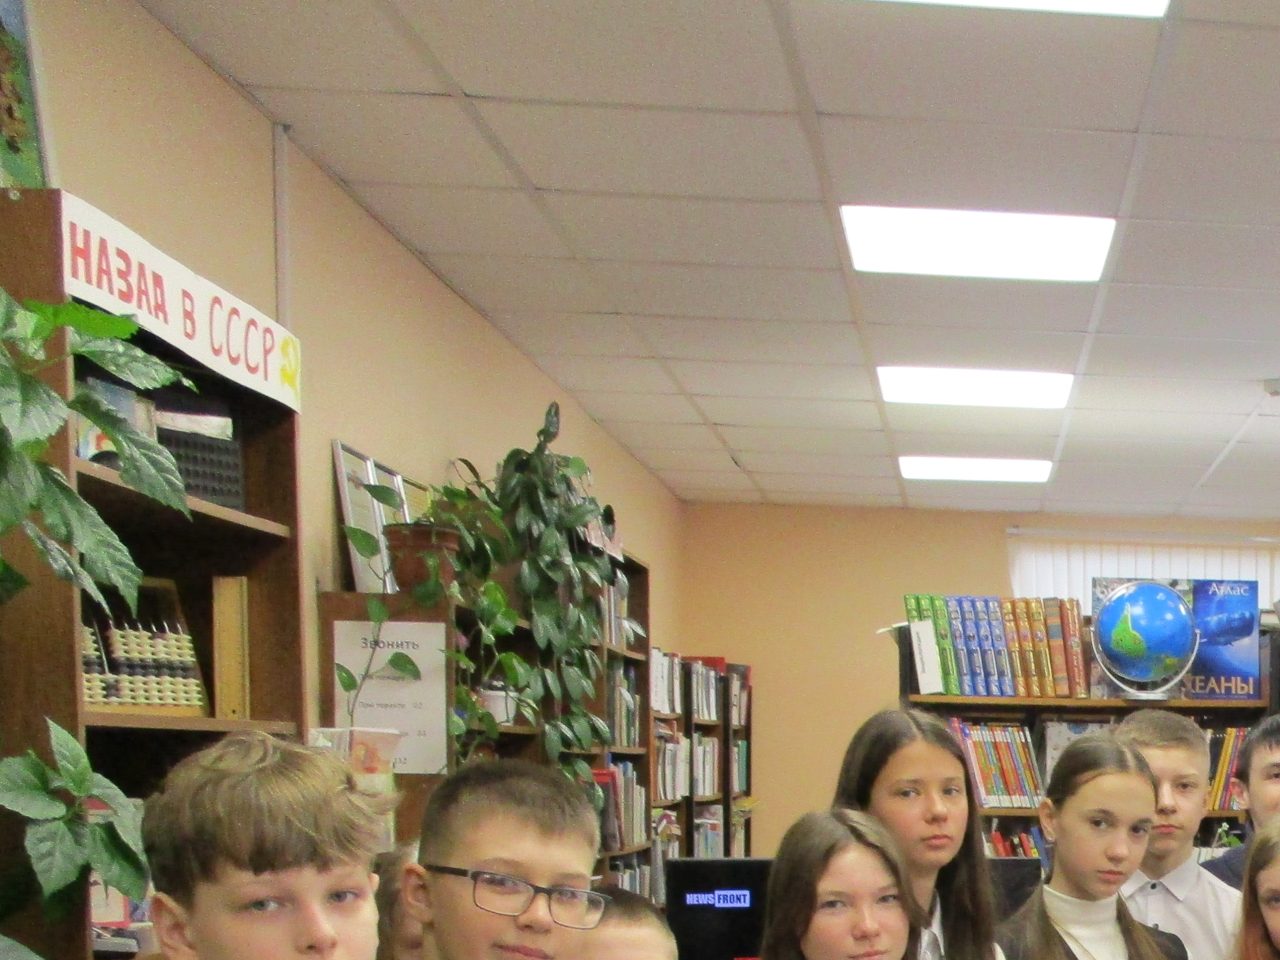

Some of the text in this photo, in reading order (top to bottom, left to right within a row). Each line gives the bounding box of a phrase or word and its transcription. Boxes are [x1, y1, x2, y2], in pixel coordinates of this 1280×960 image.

[68, 220, 276, 382] НАЗАД В СССР
[1208, 582, 1250, 597] Атлас
[686, 893, 748, 905] NEWS FRONT
